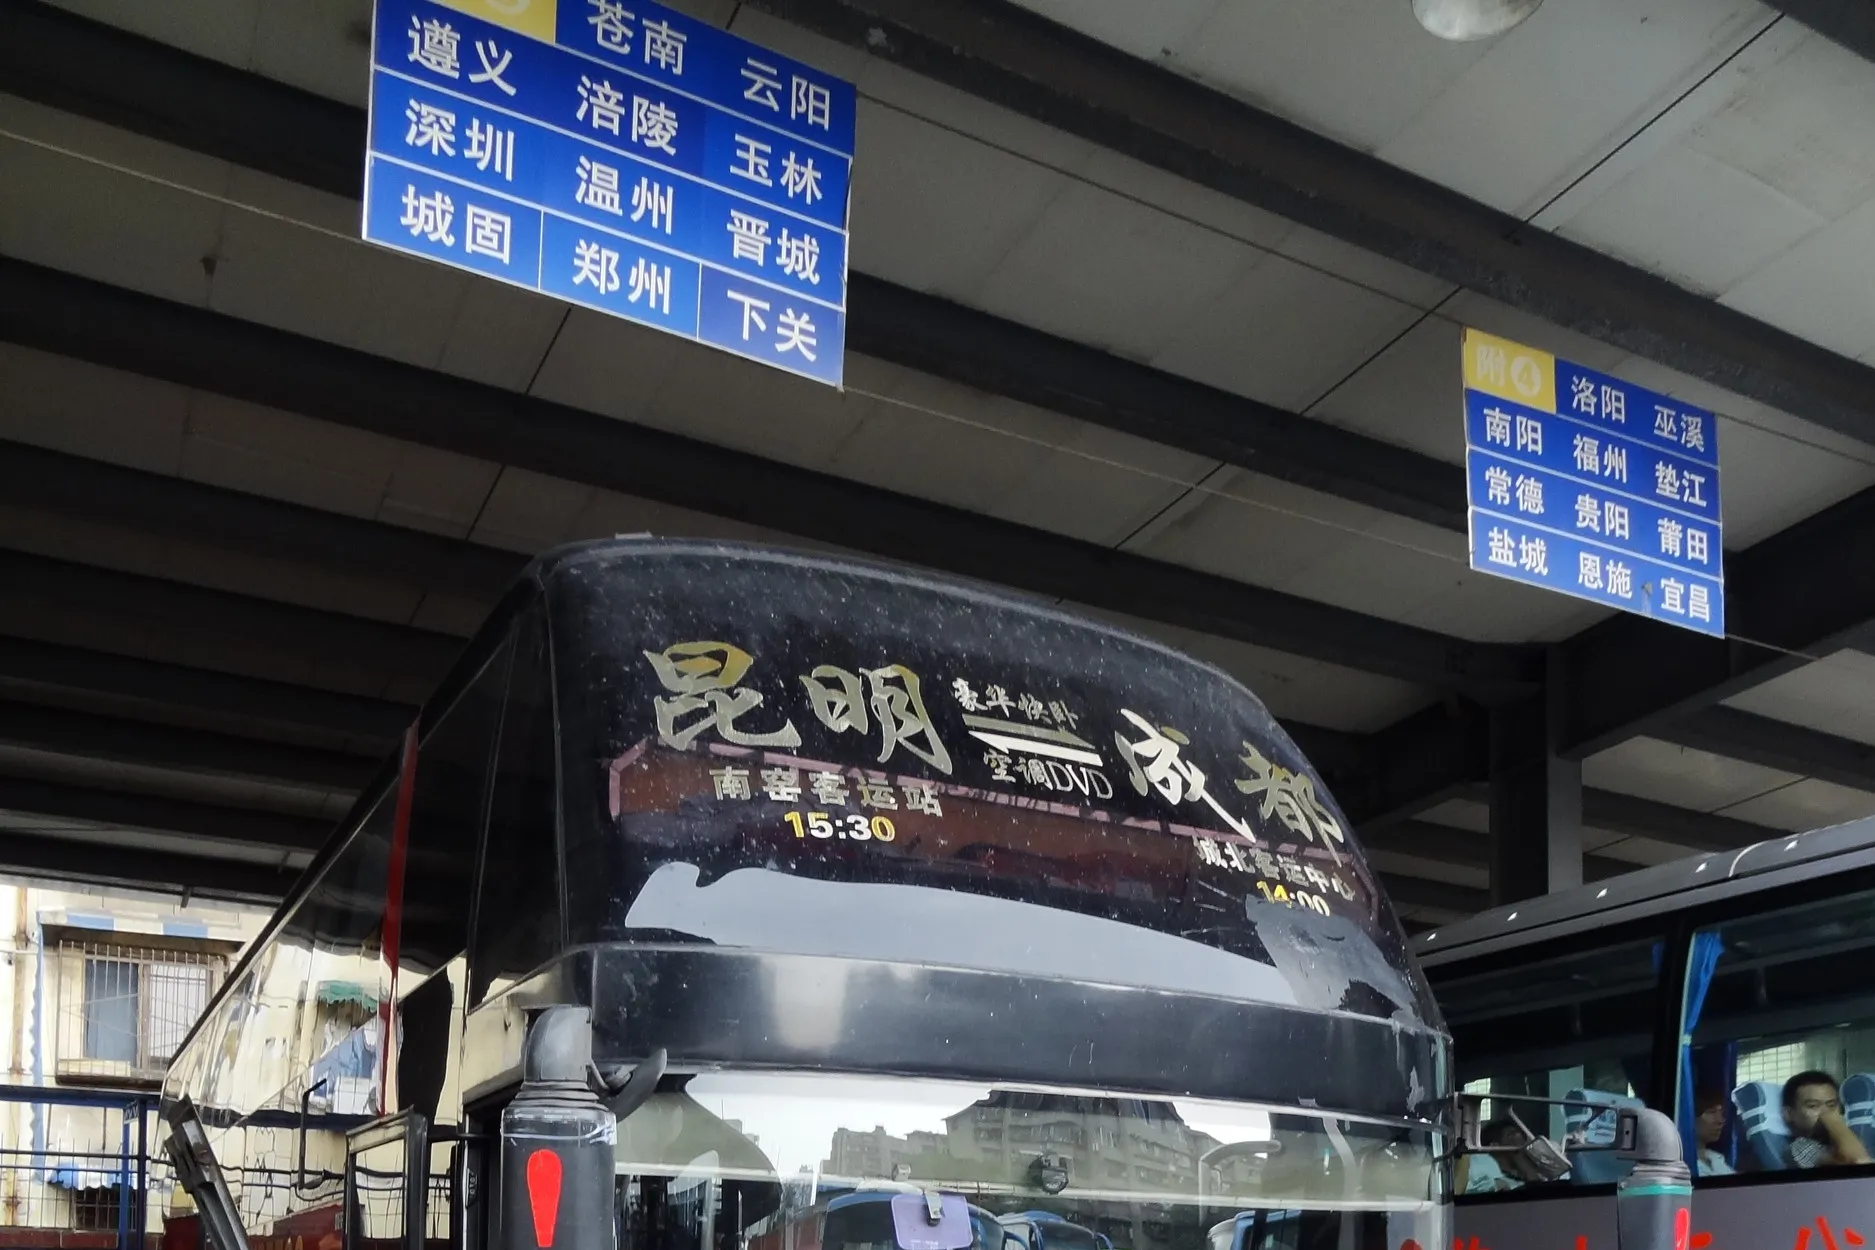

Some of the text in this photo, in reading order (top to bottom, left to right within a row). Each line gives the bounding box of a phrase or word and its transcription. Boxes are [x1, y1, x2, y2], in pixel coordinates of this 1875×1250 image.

[407, 15, 516, 96] 遵义
[586, 0, 688, 76] 苍南
[575, 75, 679, 156] 涪陵
[740, 57, 831, 132] 云阳
[404, 98, 514, 182] 深圳
[729, 134, 823, 205] 玉林
[400, 184, 512, 265] 城固
[574, 155, 674, 236] 温州
[572, 239, 671, 315] 郑州
[727, 209, 821, 286] 晋城
[727, 289, 818, 362] 下关
[1483, 407, 1543, 455] 南阳
[1571, 375, 1625, 424] 洛阳
[1654, 404, 1705, 453] 巫溪
[1485, 466, 1545, 515] 常德
[1573, 433, 1627, 483] 福州
[1655, 460, 1707, 507] 垫江
[1575, 494, 1629, 540] 贵阳
[1657, 517, 1708, 565] 莆田
[1488, 527, 1548, 577] 盐城
[1578, 551, 1633, 599] 恩施
[1660, 577, 1711, 623] 宜昌
[642, 640, 953, 775] 昆明
[708, 766, 943, 818] 南窑客运站
[1114, 708, 1345, 867] 成都
[784, 811, 896, 841] 15:30
[1192, 835, 1356, 901] 城北客运中心
